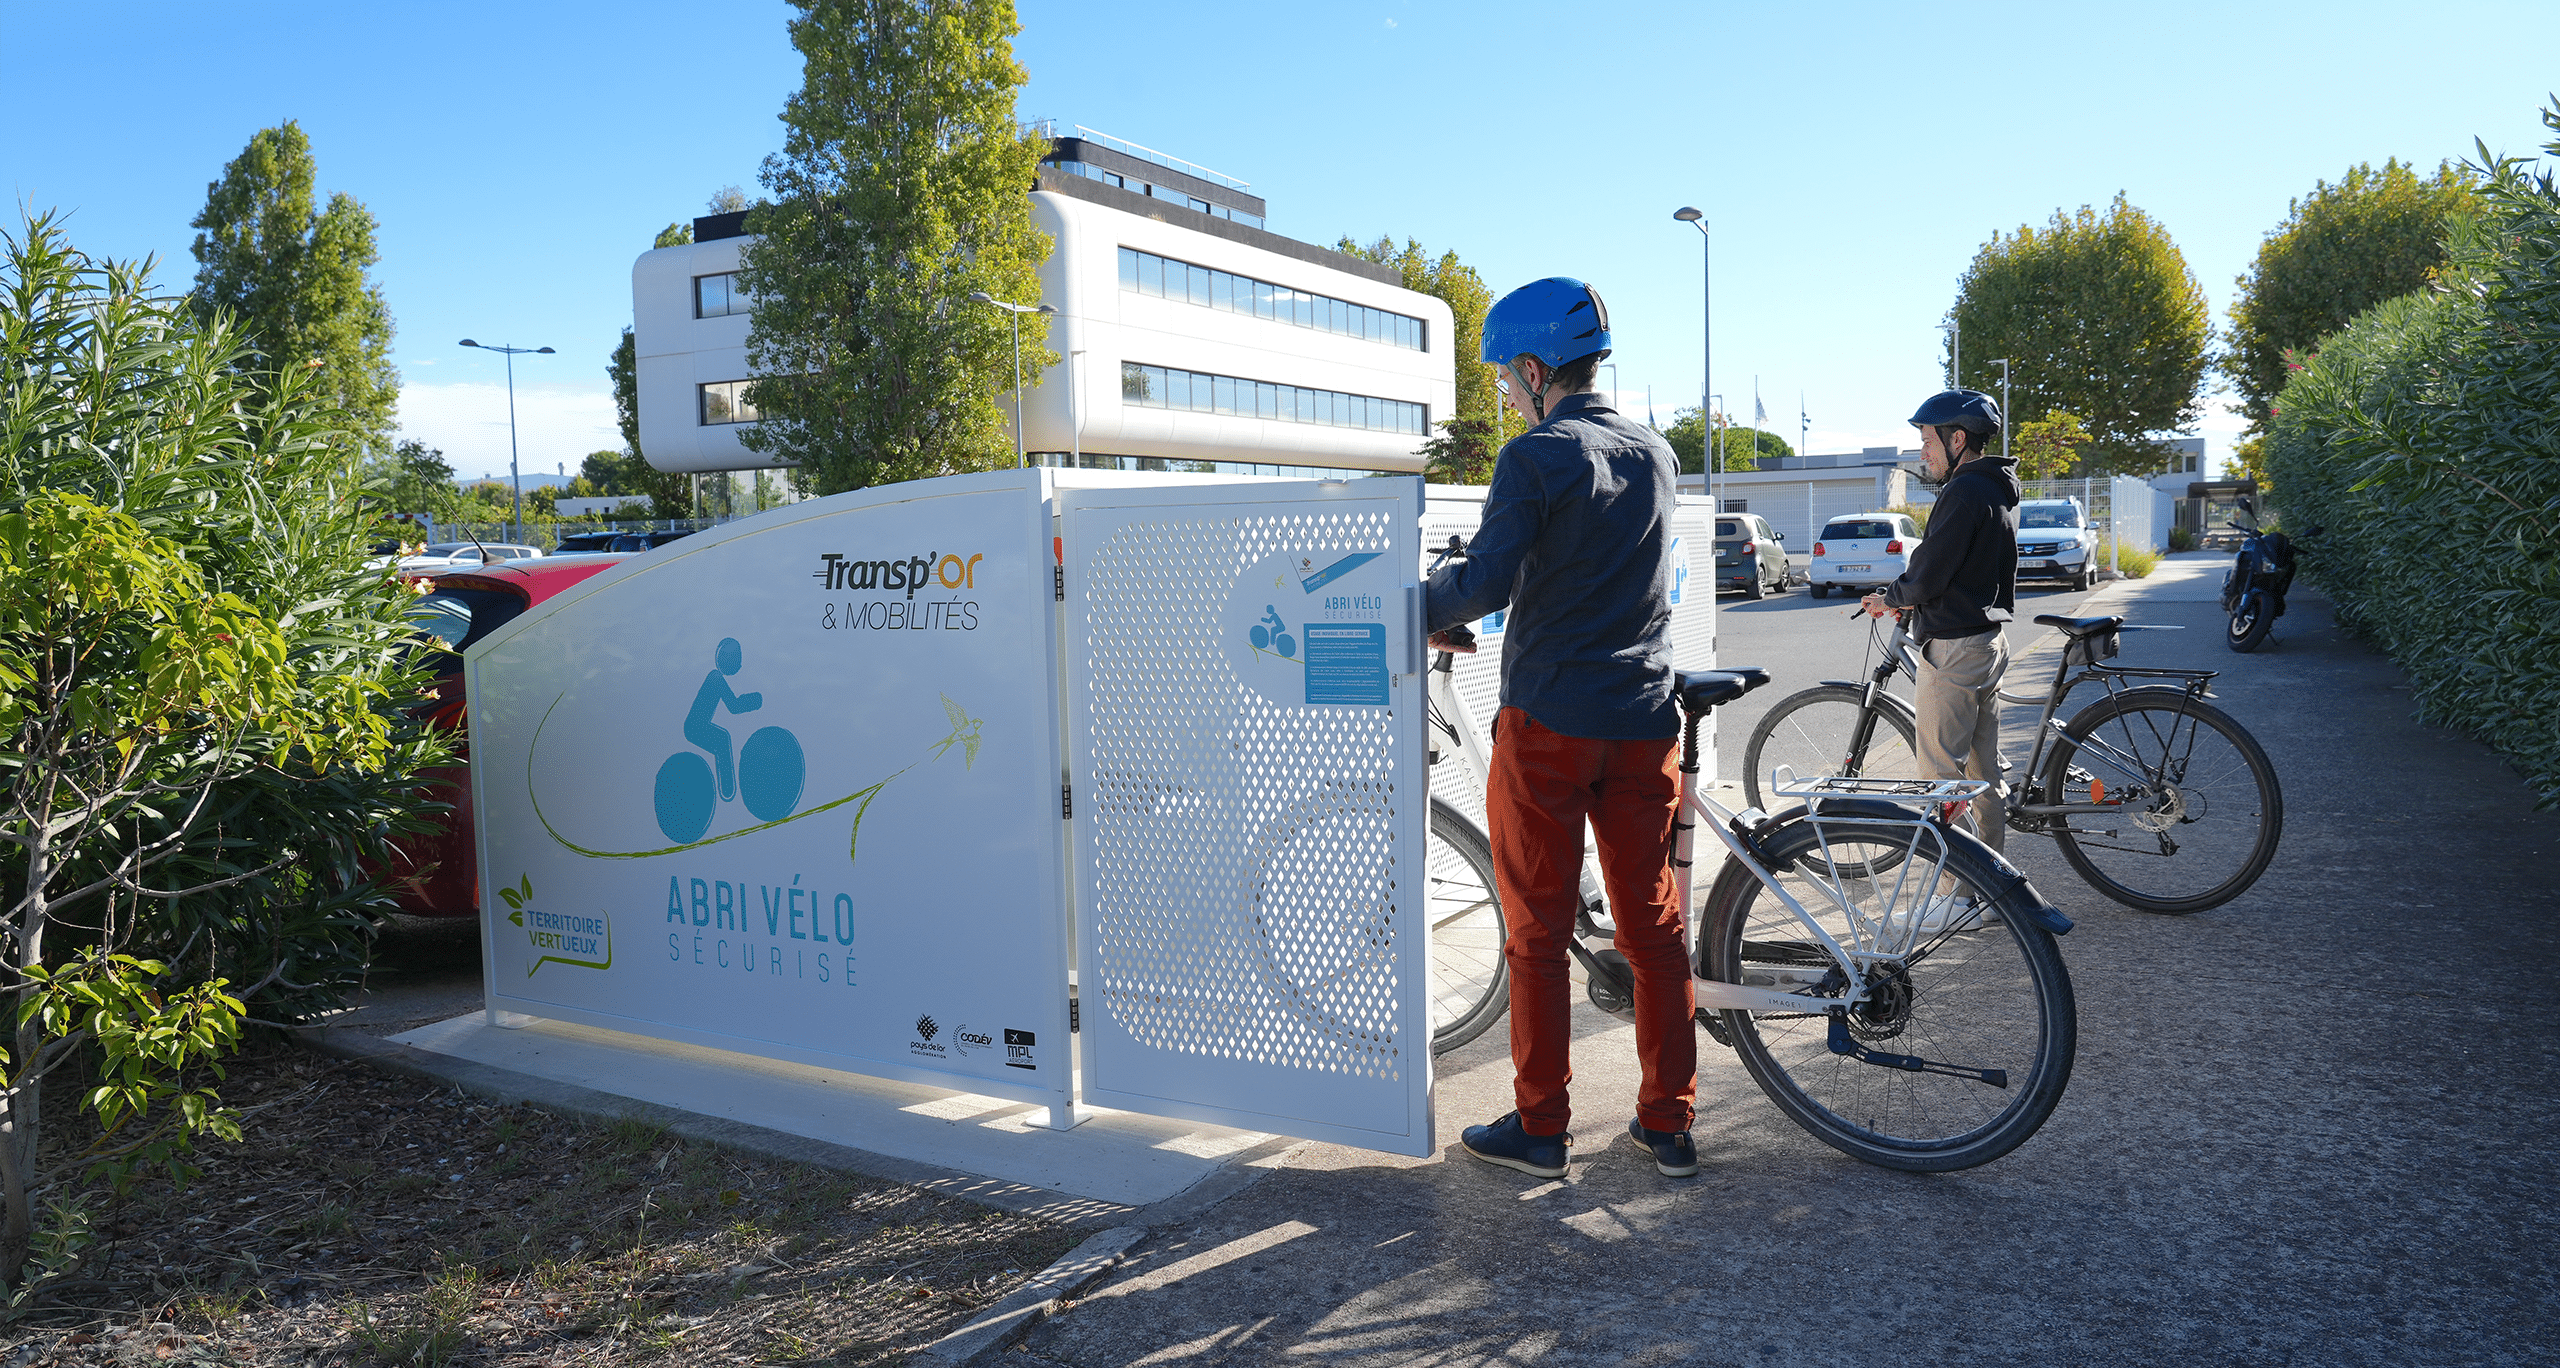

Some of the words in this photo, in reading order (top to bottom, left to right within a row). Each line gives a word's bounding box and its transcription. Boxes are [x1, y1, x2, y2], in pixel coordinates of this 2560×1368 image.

[821, 602, 838, 630] &
[844, 594, 980, 631] MOBILITÉS
[1324, 596, 1351, 610] ABRI
[1353, 593, 1382, 610] VÉLO
[1324, 610, 1382, 620] SÉCURISÉ
[527, 909, 603, 936] TERRITOIRE
[666, 875, 748, 933] ABRI
[760, 873, 856, 948] VÉLO
[528, 930, 598, 956] VERTUEUX
[668, 928, 858, 987] SÉCURISÉ
[1768, 998, 1796, 1009] IMAGE
[1007, 1045, 1034, 1059] MPL
